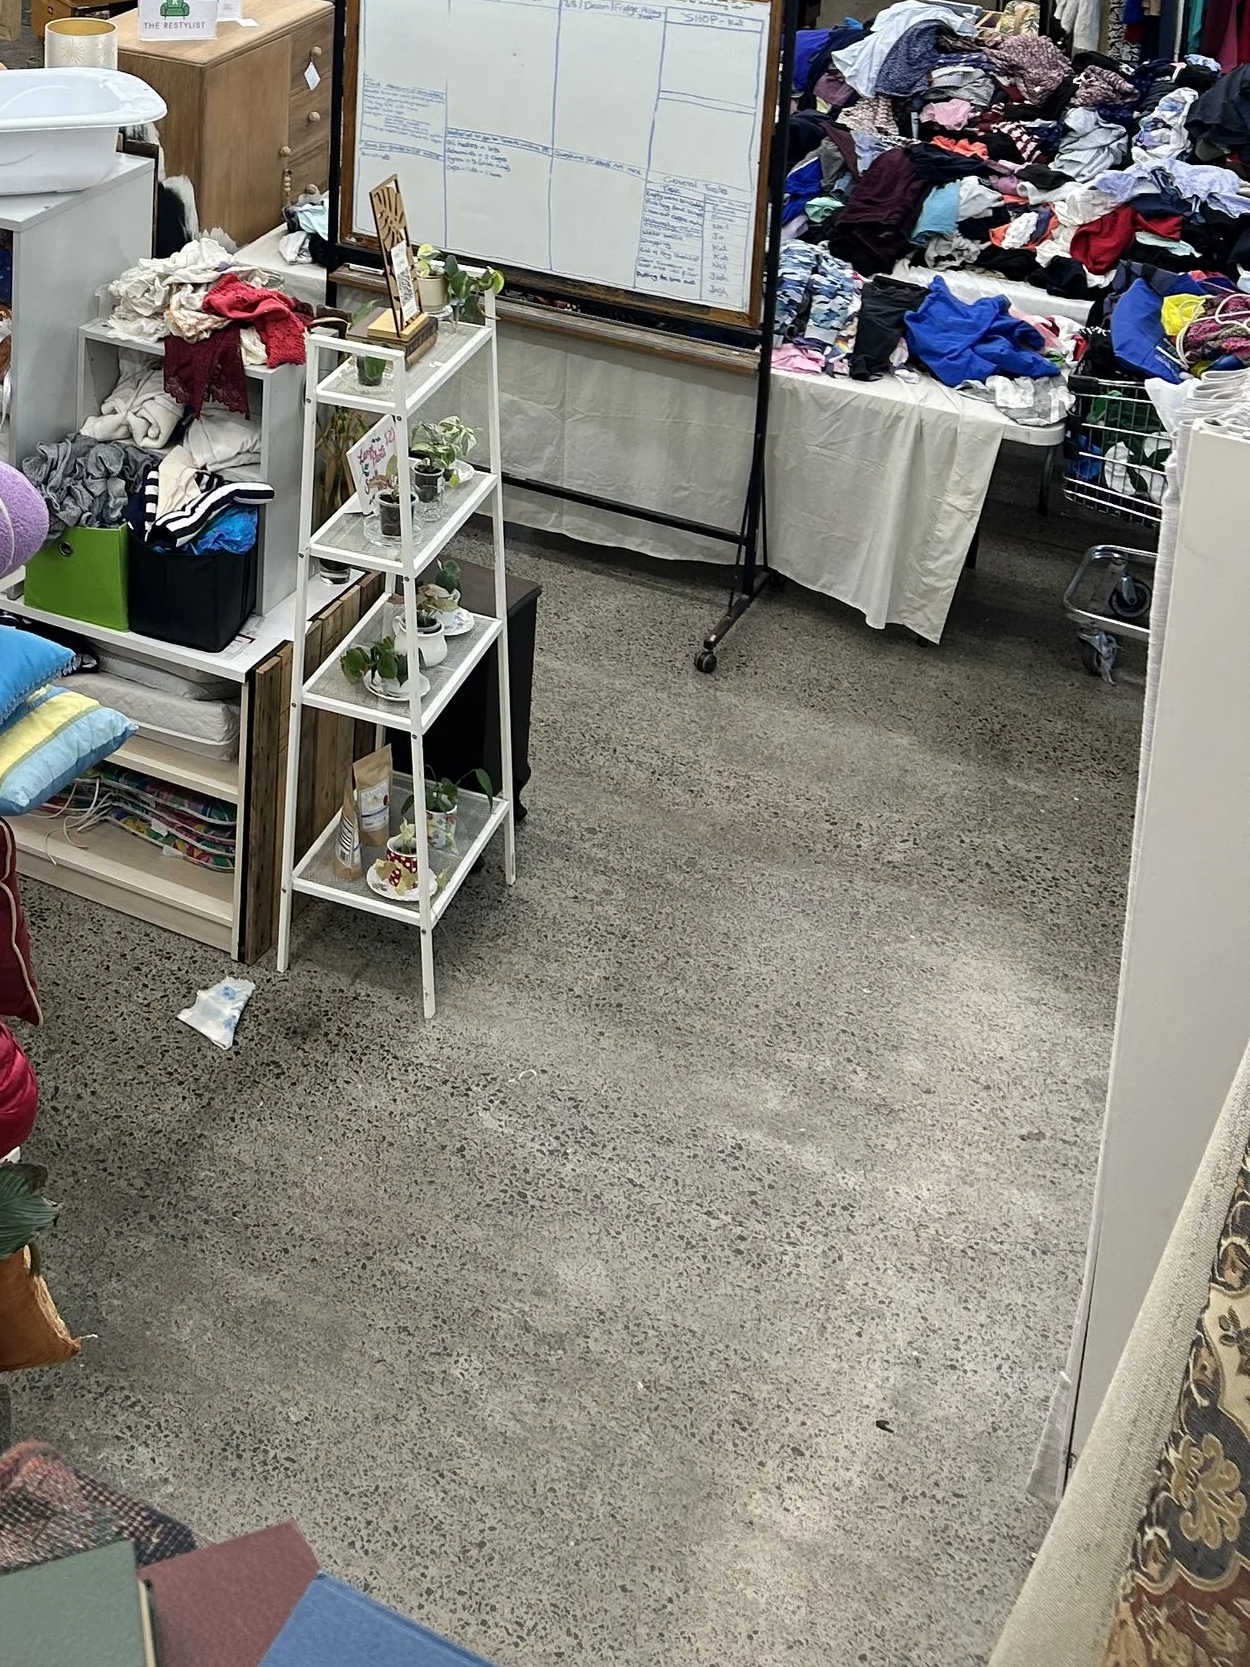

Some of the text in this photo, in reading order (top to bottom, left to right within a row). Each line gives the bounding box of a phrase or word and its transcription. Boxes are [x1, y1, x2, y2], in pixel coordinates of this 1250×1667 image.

[684, 13, 718, 24] SHOP
[164, 21, 206, 29] RESTYLIST
[663, 176, 698, 188] General
